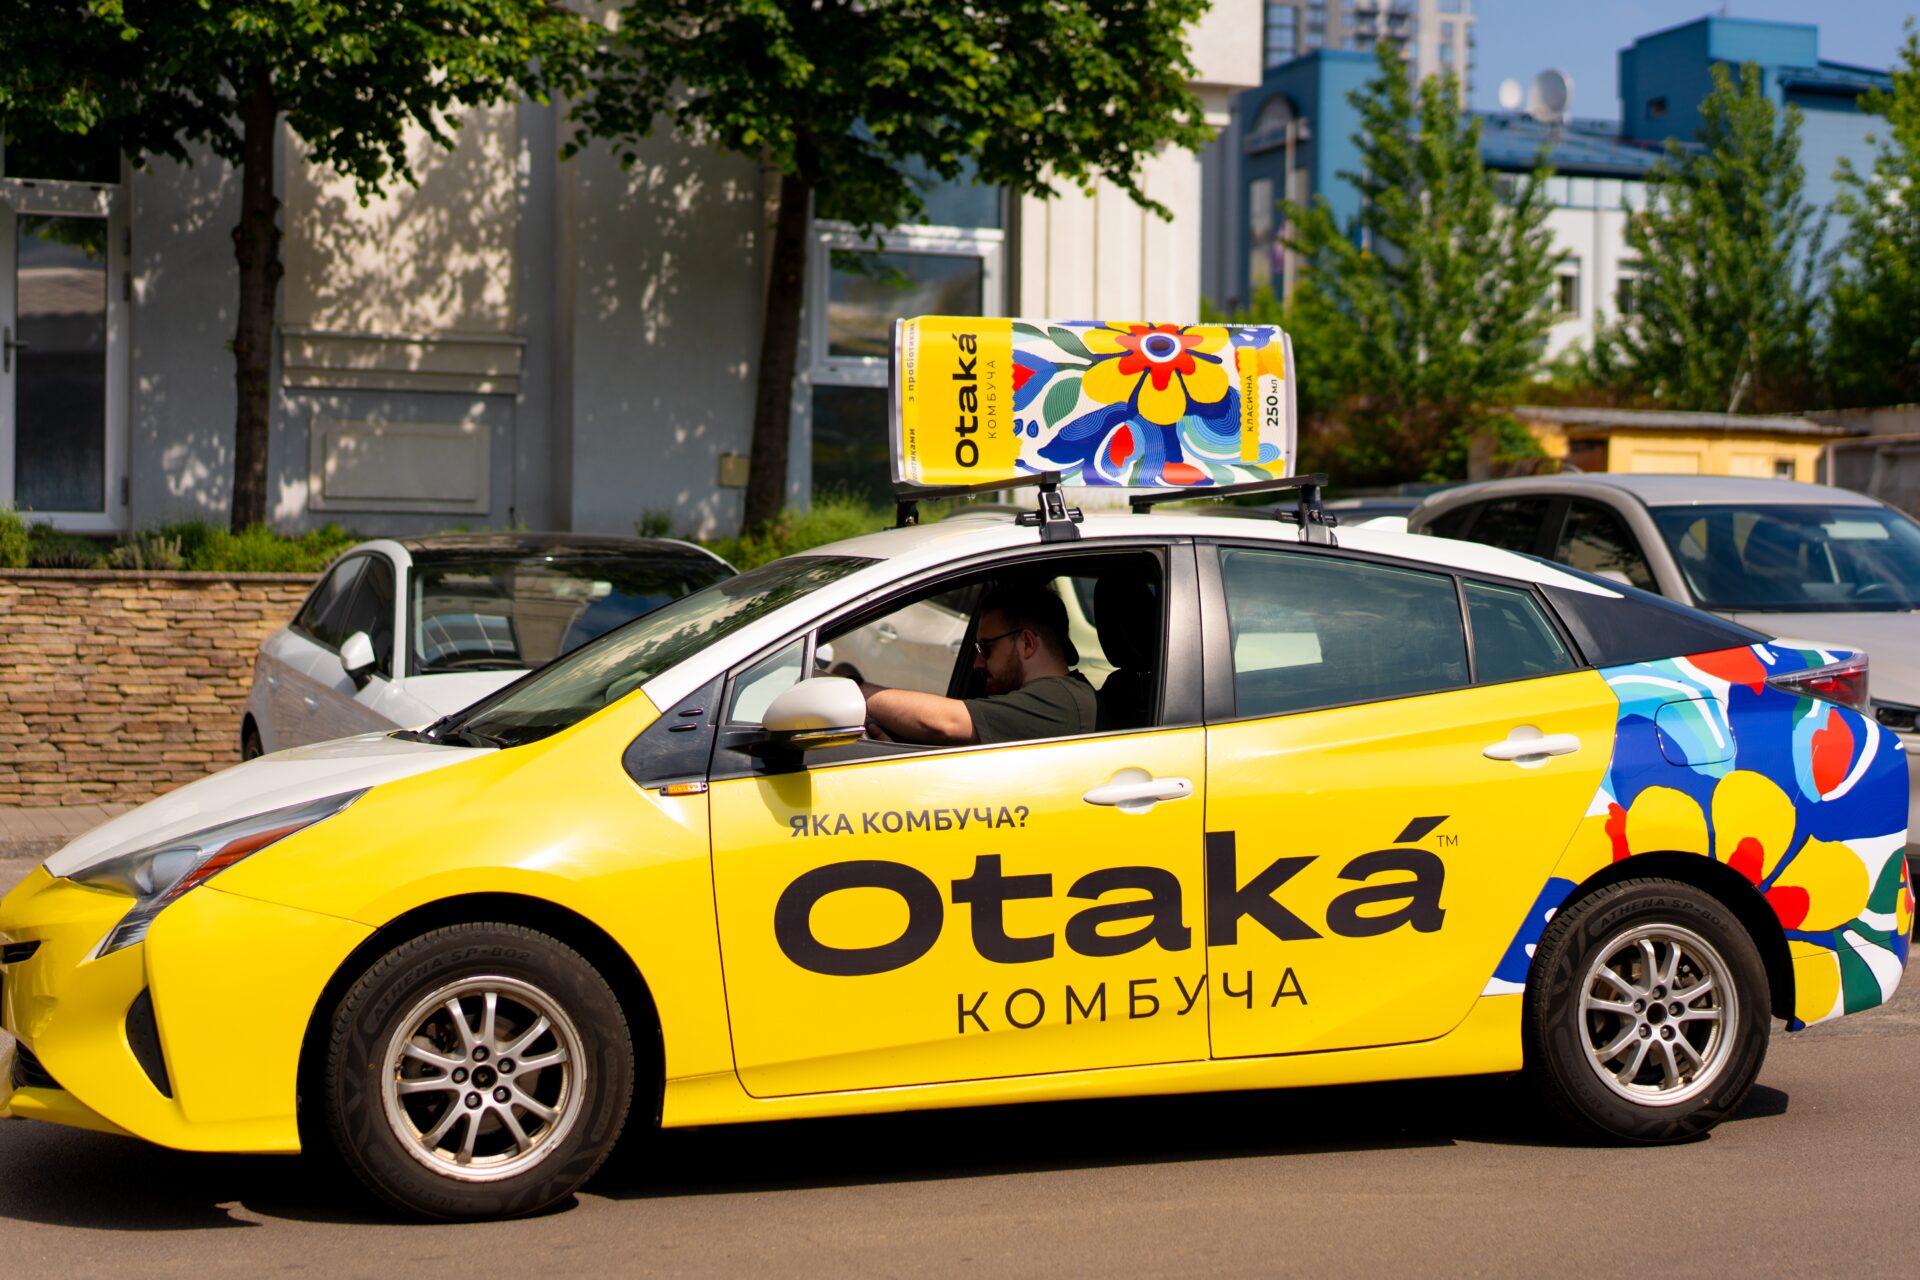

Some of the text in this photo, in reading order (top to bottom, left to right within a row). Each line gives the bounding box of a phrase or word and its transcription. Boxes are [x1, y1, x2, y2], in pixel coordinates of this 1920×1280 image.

[952, 332, 979, 468] Otaká
[987, 360, 997, 439] КОМБУЧА
[1266, 395, 1278, 427] 250
[789, 806, 1030, 837] ЯКА КОМБУЧА?
[774, 815, 1458, 977] Otaká TM
[1600, 898, 1665, 929] ATHENA
[373, 946, 531, 1021] ATHENA SP-802
[957, 966, 1309, 1034] КОМБУЧА
